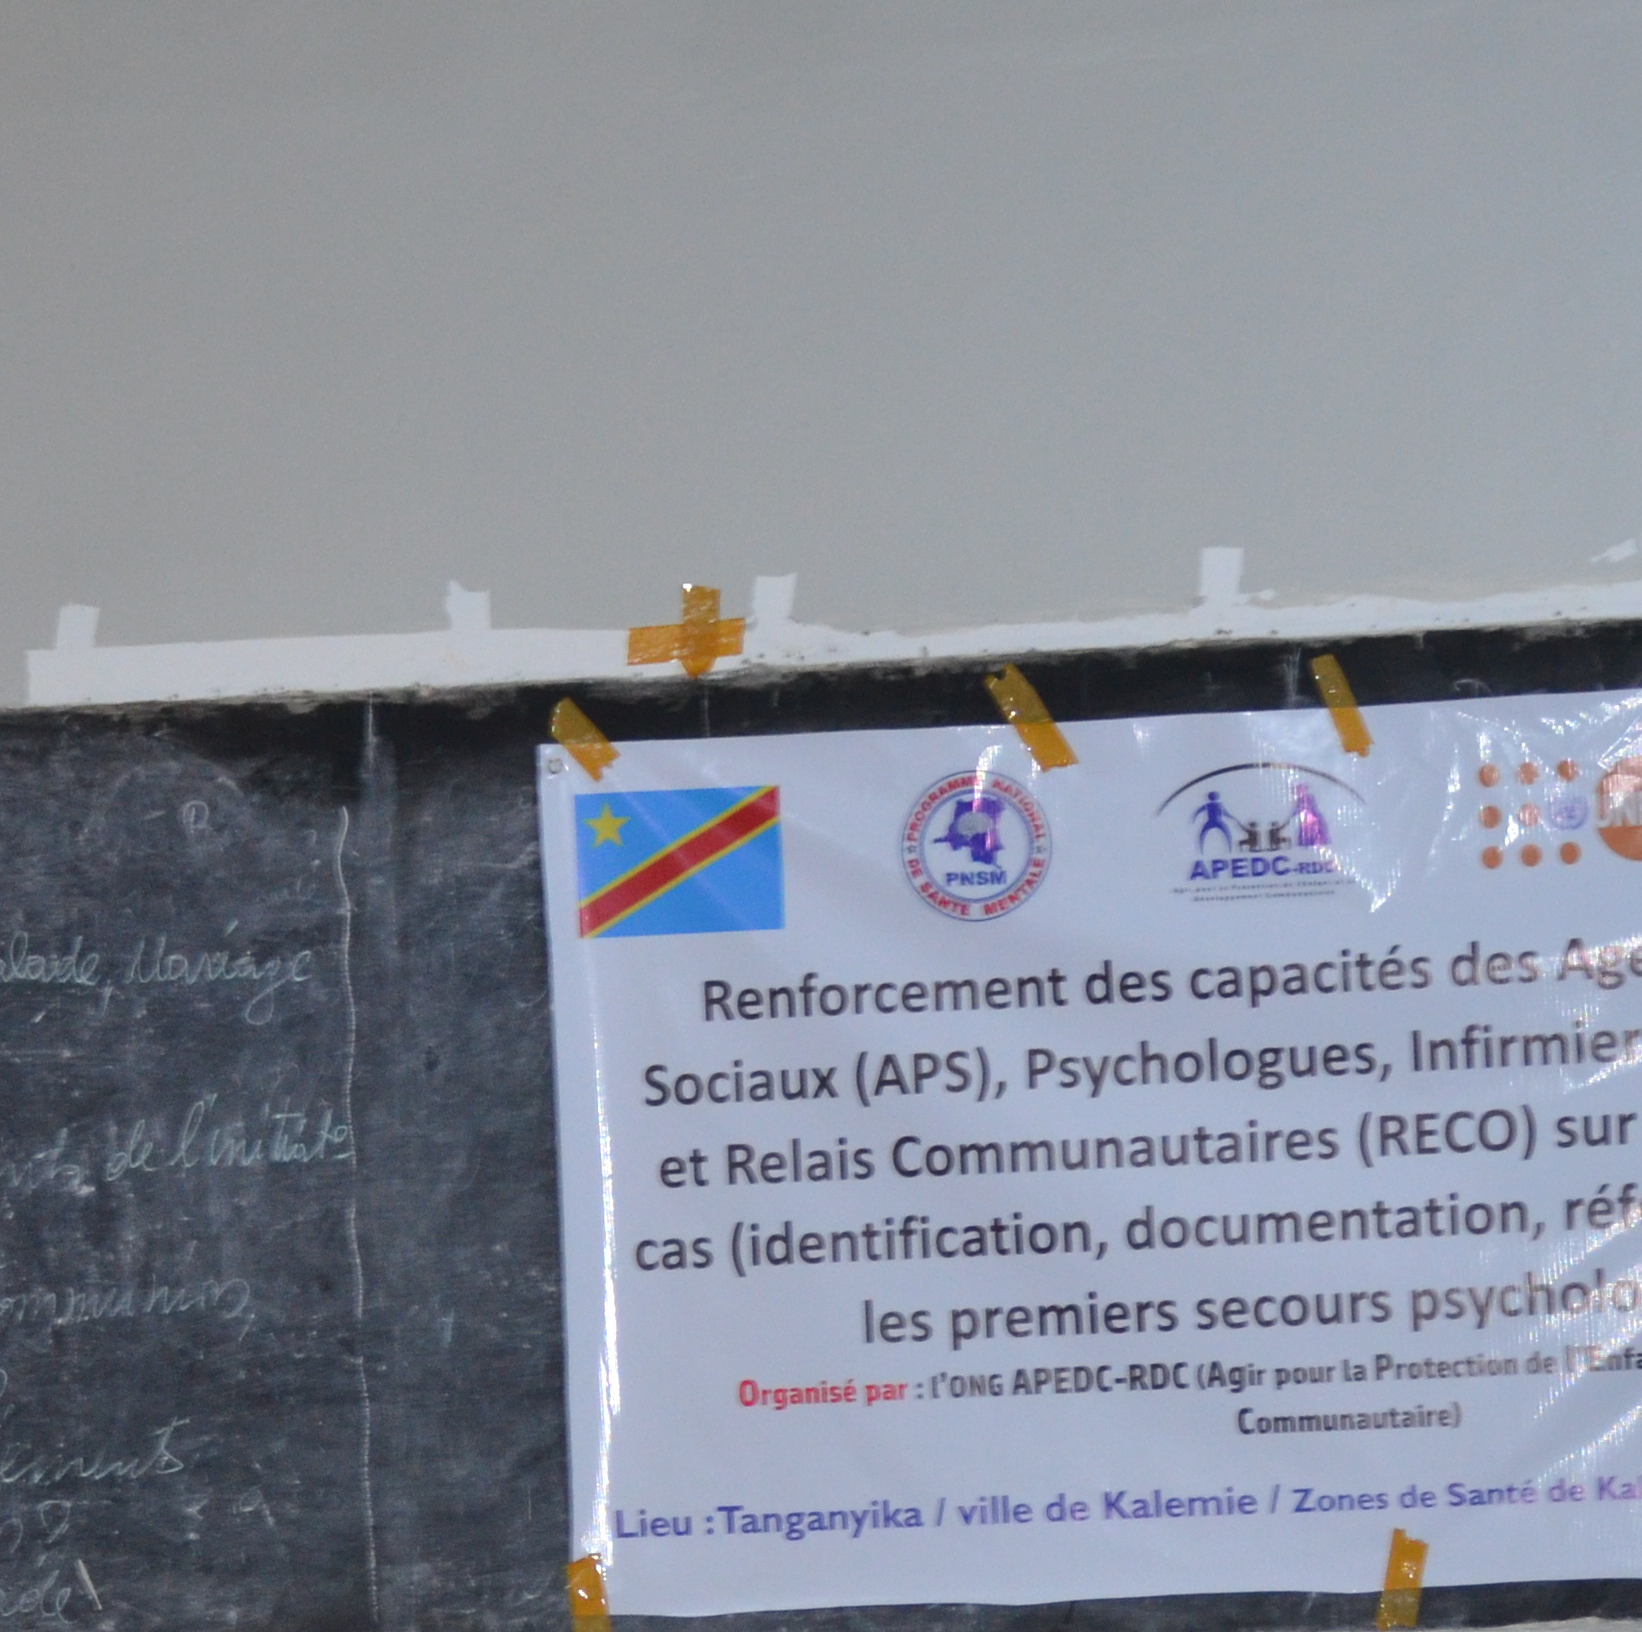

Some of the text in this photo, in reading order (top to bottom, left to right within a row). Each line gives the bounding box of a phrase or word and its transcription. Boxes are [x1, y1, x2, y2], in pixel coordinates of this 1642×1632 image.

[945, 870, 1008, 887] PNSM
[703, 968, 1068, 1022] Renforcement
[1085, 959, 1172, 1005] des
[1189, 944, 1430, 1009] capacités
[1450, 938, 1541, 987] des
[644, 1059, 838, 1107] Sociaux
[855, 1047, 1006, 1108] (APS),
[1027, 1037, 1391, 1098] Psychologues,
[659, 1148, 709, 1189] et
[727, 1137, 875, 1185] Relais
[891, 1119, 1339, 1178] Communautaires
[1359, 1104, 1537, 1168] (RECO)
[1556, 1112, 1637, 1149] sur
[635, 1237, 713, 1271] cas
[731, 1212, 1107, 1278] (identification,
[1125, 1192, 1544, 1251] documentation,
[864, 1299, 932, 1344] les
[951, 1291, 1179, 1351] premiers
[1196, 1290, 1391, 1331] secours
[738, 1379, 857, 1411] Organisé
[864, 1383, 908, 1407] par
[931, 1371, 1004, 1399] l'ONG
[1012, 1361, 1190, 1395] APEDC-RDC
[1196, 1360, 1265, 1394] (Agir
[1274, 1364, 1337, 1391] pour
[1343, 1359, 1367, 1382] la
[1374, 1353, 1517, 1381] Protection
[1525, 1350, 1555, 1375] de
[1237, 1403, 1460, 1436] Communautaire)
[615, 1509, 692, 1539] Lieu
[705, 1499, 924, 1541] :Tanganyika
[957, 1495, 1033, 1526] ville
[1045, 1492, 1089, 1523] de
[1103, 1486, 1258, 1520] Kalemie
[1292, 1487, 1388, 1513] Zones
[1399, 1484, 1437, 1509] de
[1447, 1476, 1538, 1508] Santé
[1547, 1477, 1586, 1503] de
